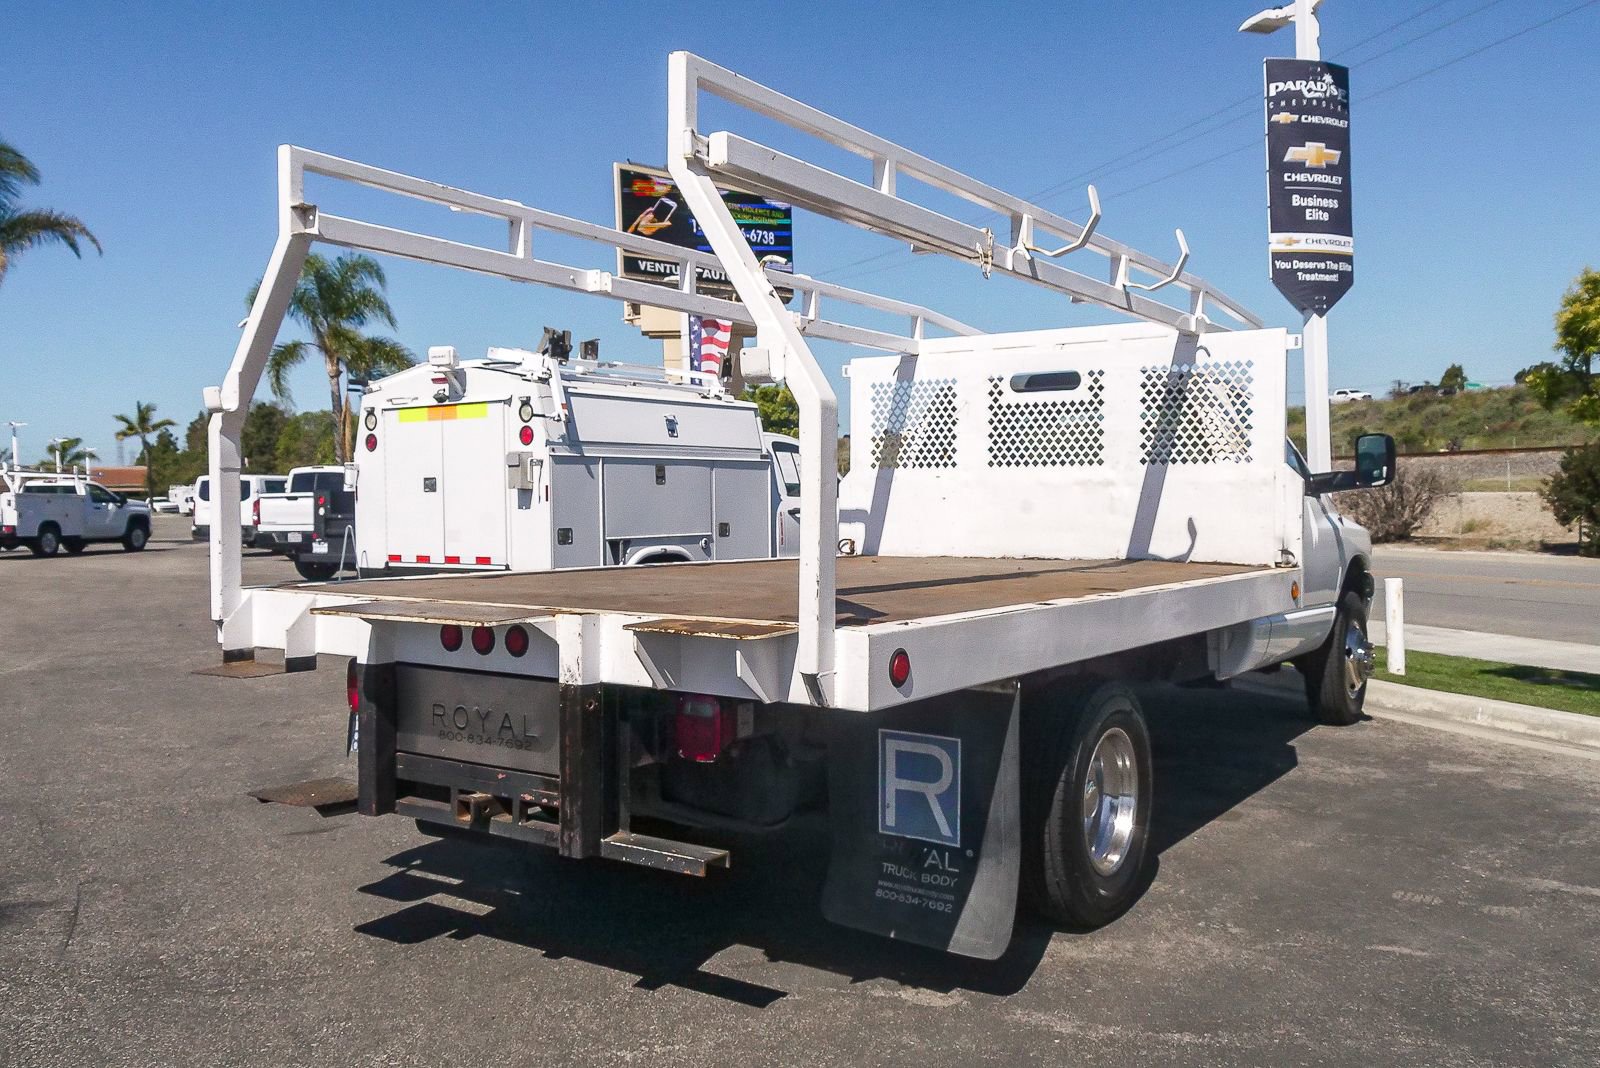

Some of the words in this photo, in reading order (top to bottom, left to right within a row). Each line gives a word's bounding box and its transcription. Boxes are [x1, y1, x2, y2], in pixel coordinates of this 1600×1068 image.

[1301, 114, 1348, 128] CHEVROLET
[1283, 172, 1343, 185] CHEVROLET
[1292, 194, 1339, 208] Business
[1305, 209, 1330, 221] Elite
[1305, 238, 1351, 248] CHEVROLET
[1274, 260, 1291, 270] You
[1293, 260, 1326, 270] Deserve
[1326, 261, 1339, 271] The
[1339, 262, 1352, 272] Elite
[432, 703, 539, 739] ROYAL
[439, 729, 533, 752] 800-834-7692
[885, 738, 954, 838] R
[881, 862, 918, 881] TRUCK
[921, 873, 959, 888] BODY
